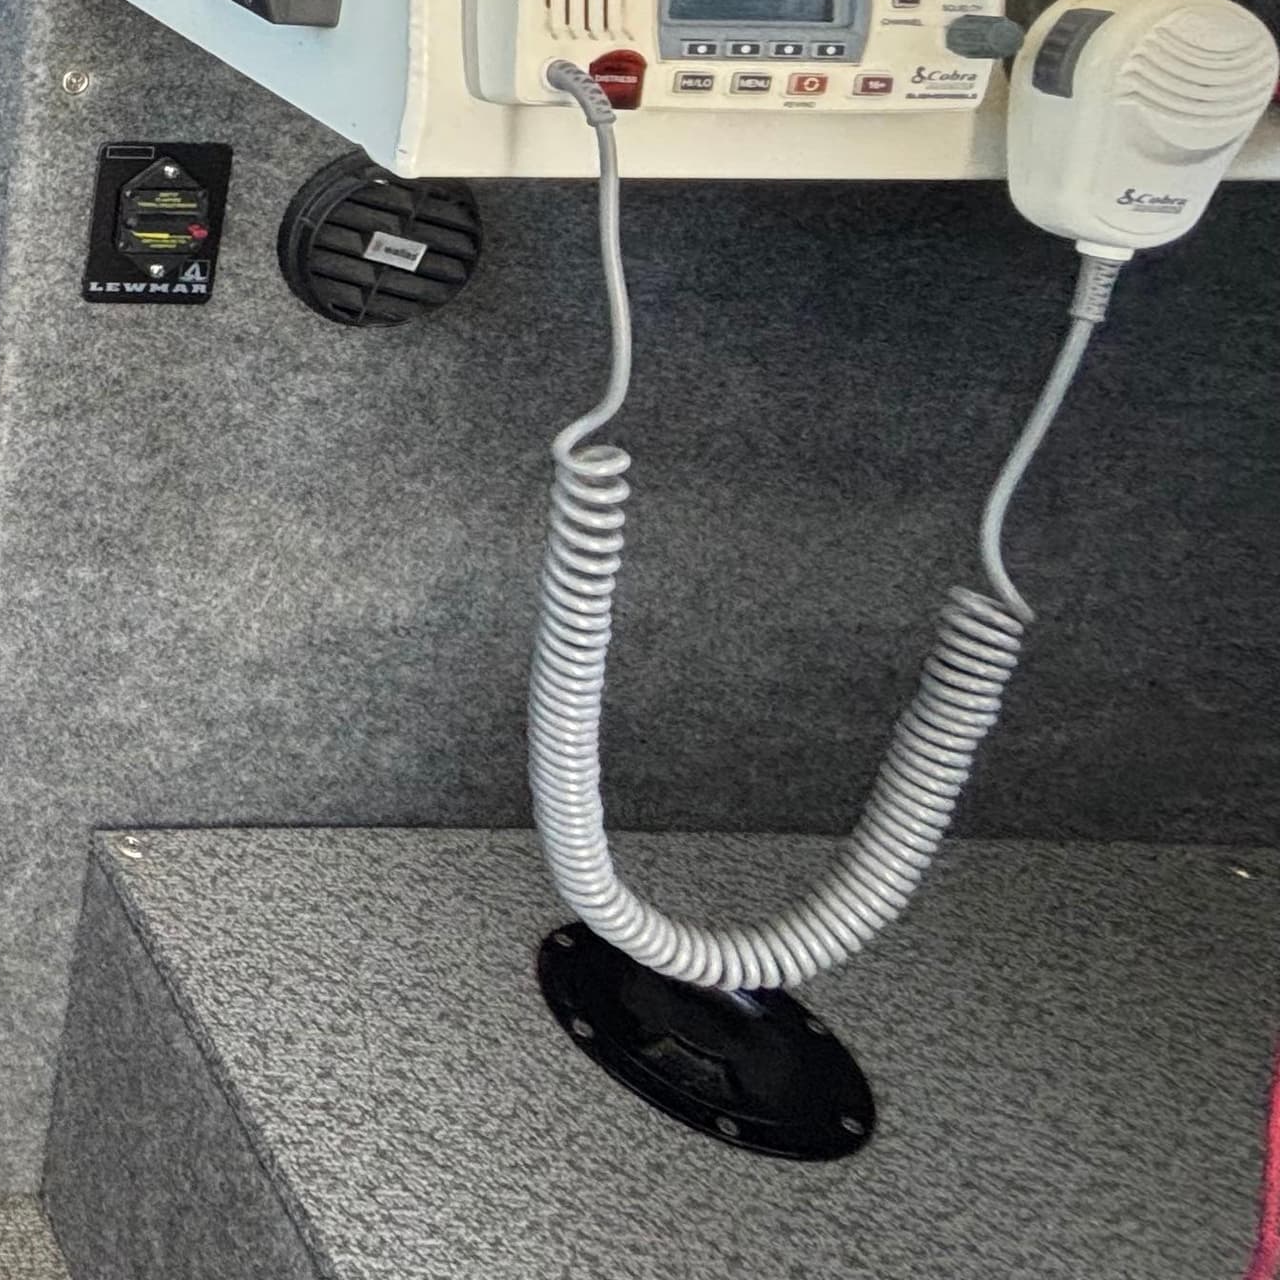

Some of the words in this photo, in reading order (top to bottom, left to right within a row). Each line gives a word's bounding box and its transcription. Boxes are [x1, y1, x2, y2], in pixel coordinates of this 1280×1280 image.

[926, 69, 978, 81] Cobra
[681, 78, 712, 88] HI/LO
[739, 78, 770, 88] MENU
[1132, 193, 1187, 205] Cobra
[89, 282, 207, 293] LEWMAR
